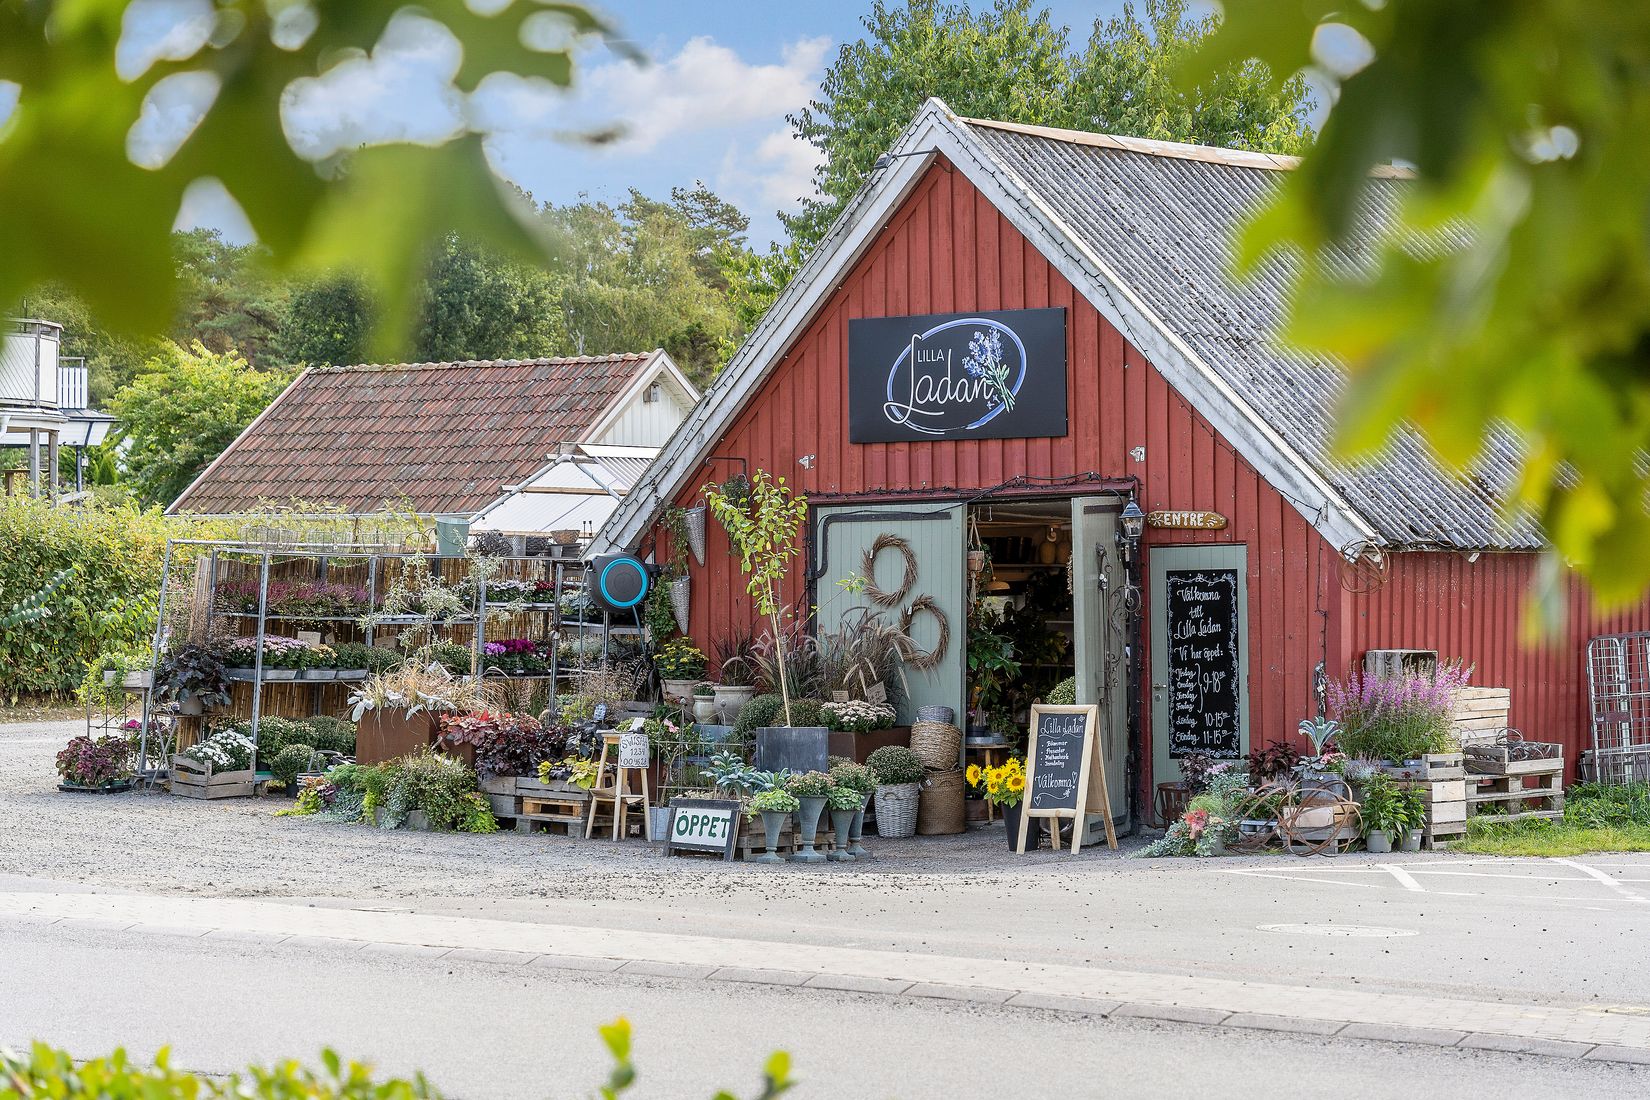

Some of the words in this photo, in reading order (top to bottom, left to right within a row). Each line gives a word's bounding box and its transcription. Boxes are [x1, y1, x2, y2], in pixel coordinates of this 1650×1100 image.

[917, 349, 945, 362] LILLA
[883, 334, 994, 424] Ladan
[1163, 512, 1204, 527] ENTRE
[1189, 605, 1204, 619] till
[1173, 619, 1197, 640] Lilla
[1197, 616, 1222, 637] Ladan
[1173, 644, 1189, 661] Vi
[1190, 643, 1202, 659] har
[1040, 717, 1061, 734] Lilla
[1062, 716, 1084, 734] Ladan
[676, 811, 730, 839] ÖPPET
